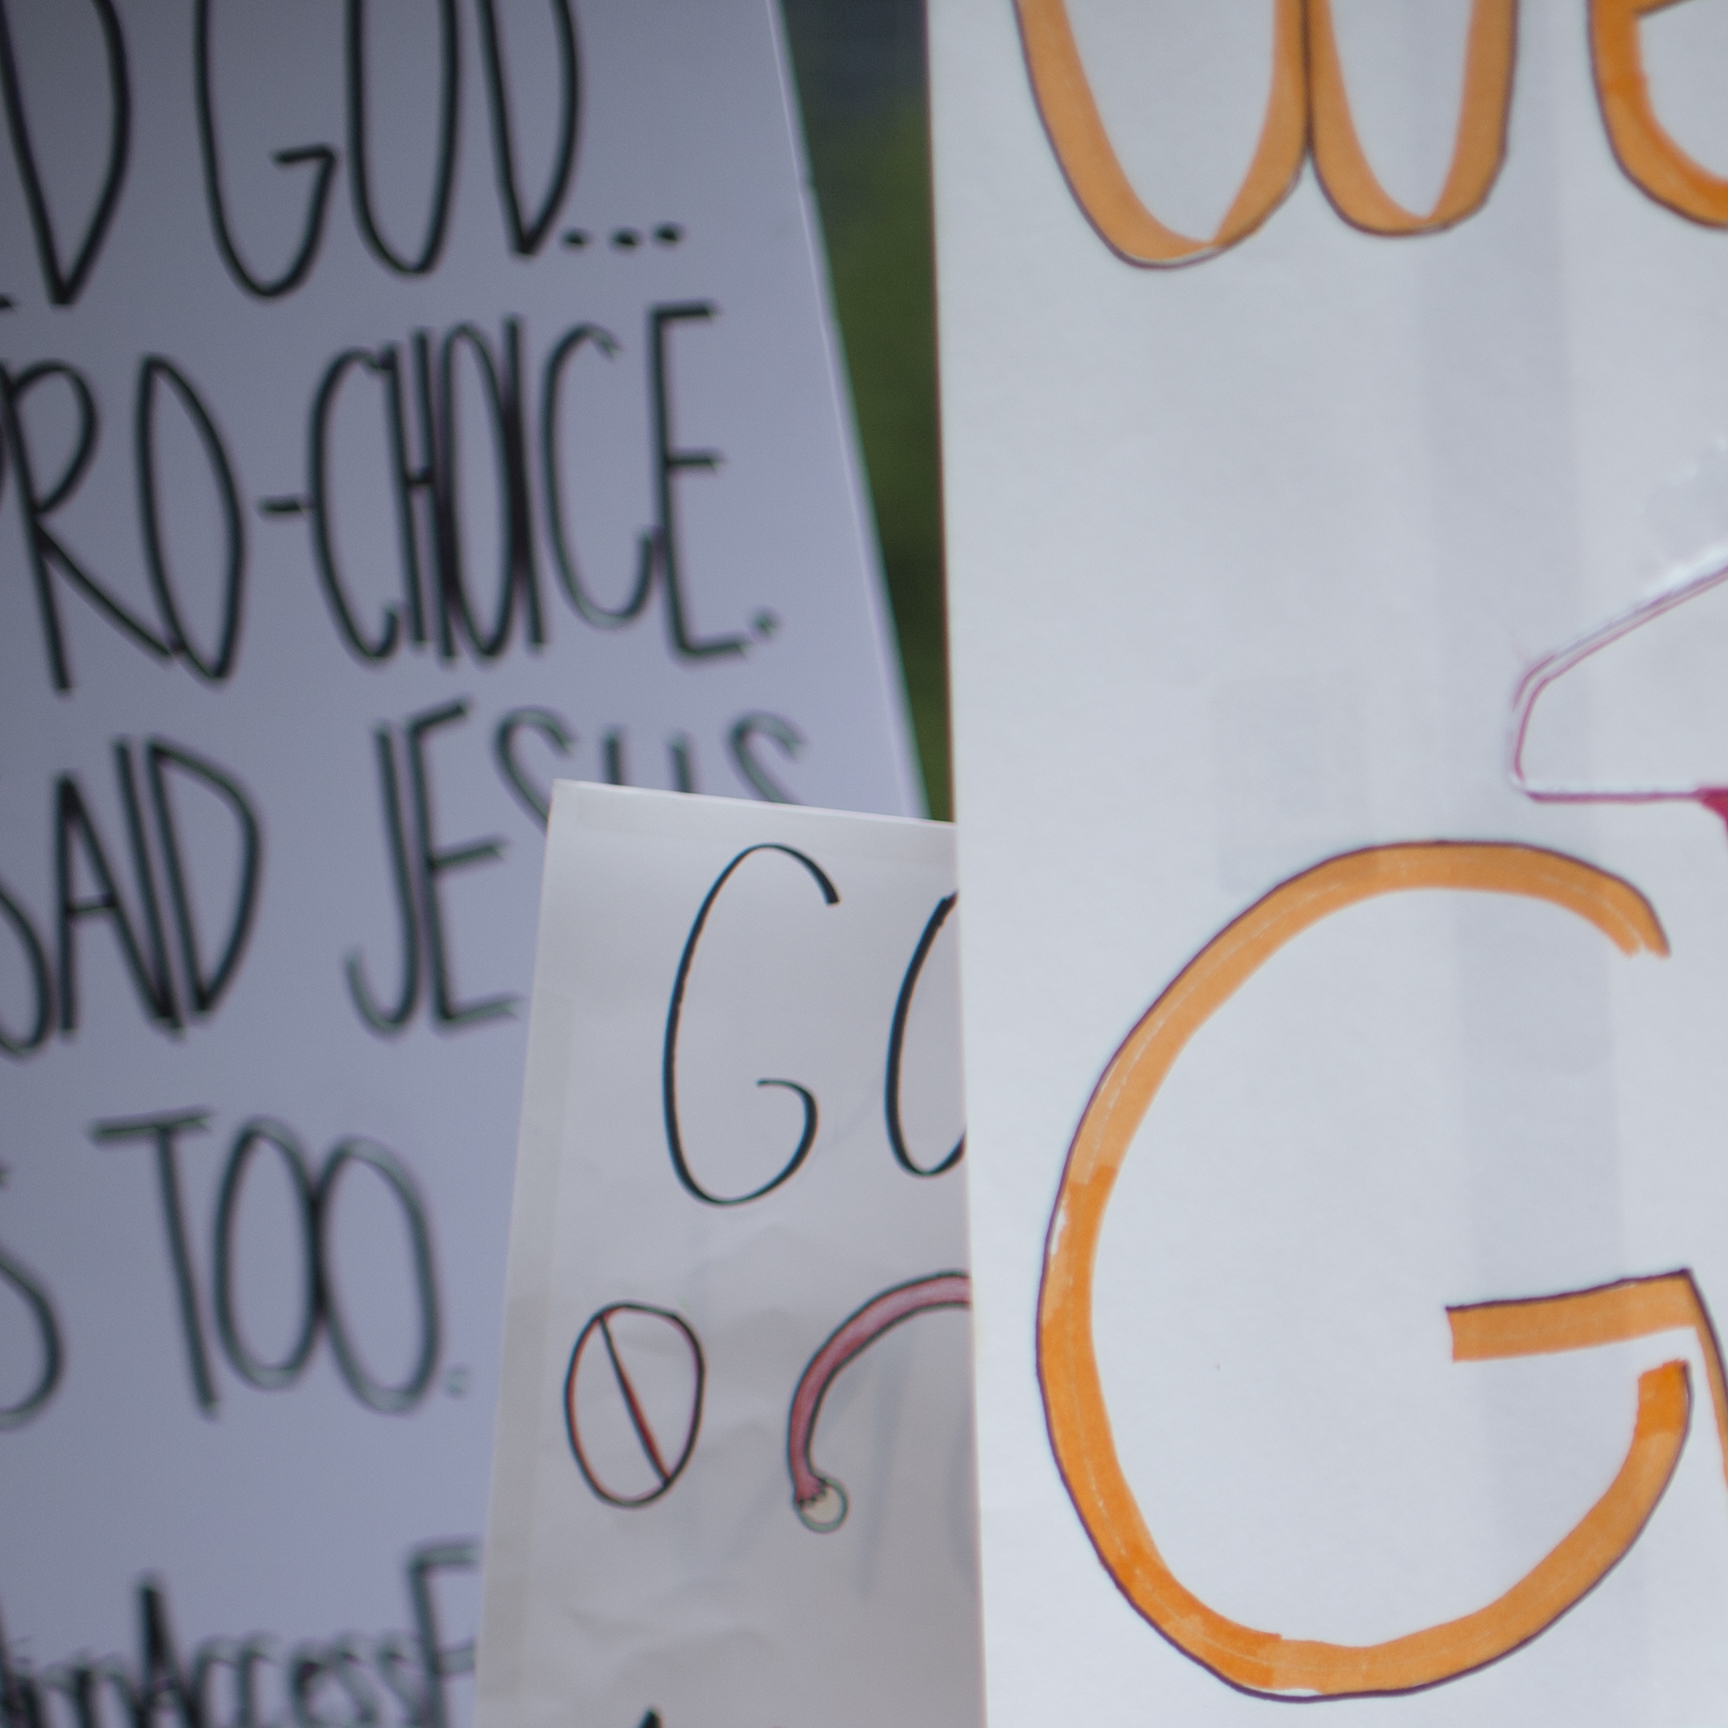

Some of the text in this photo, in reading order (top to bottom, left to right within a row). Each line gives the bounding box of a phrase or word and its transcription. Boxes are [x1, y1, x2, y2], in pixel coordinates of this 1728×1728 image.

[0, 0, 133, 308] D
[0, 300, 780, 695] RO-CHOICE.
[92, 1110, 472, 1420] TOO.
